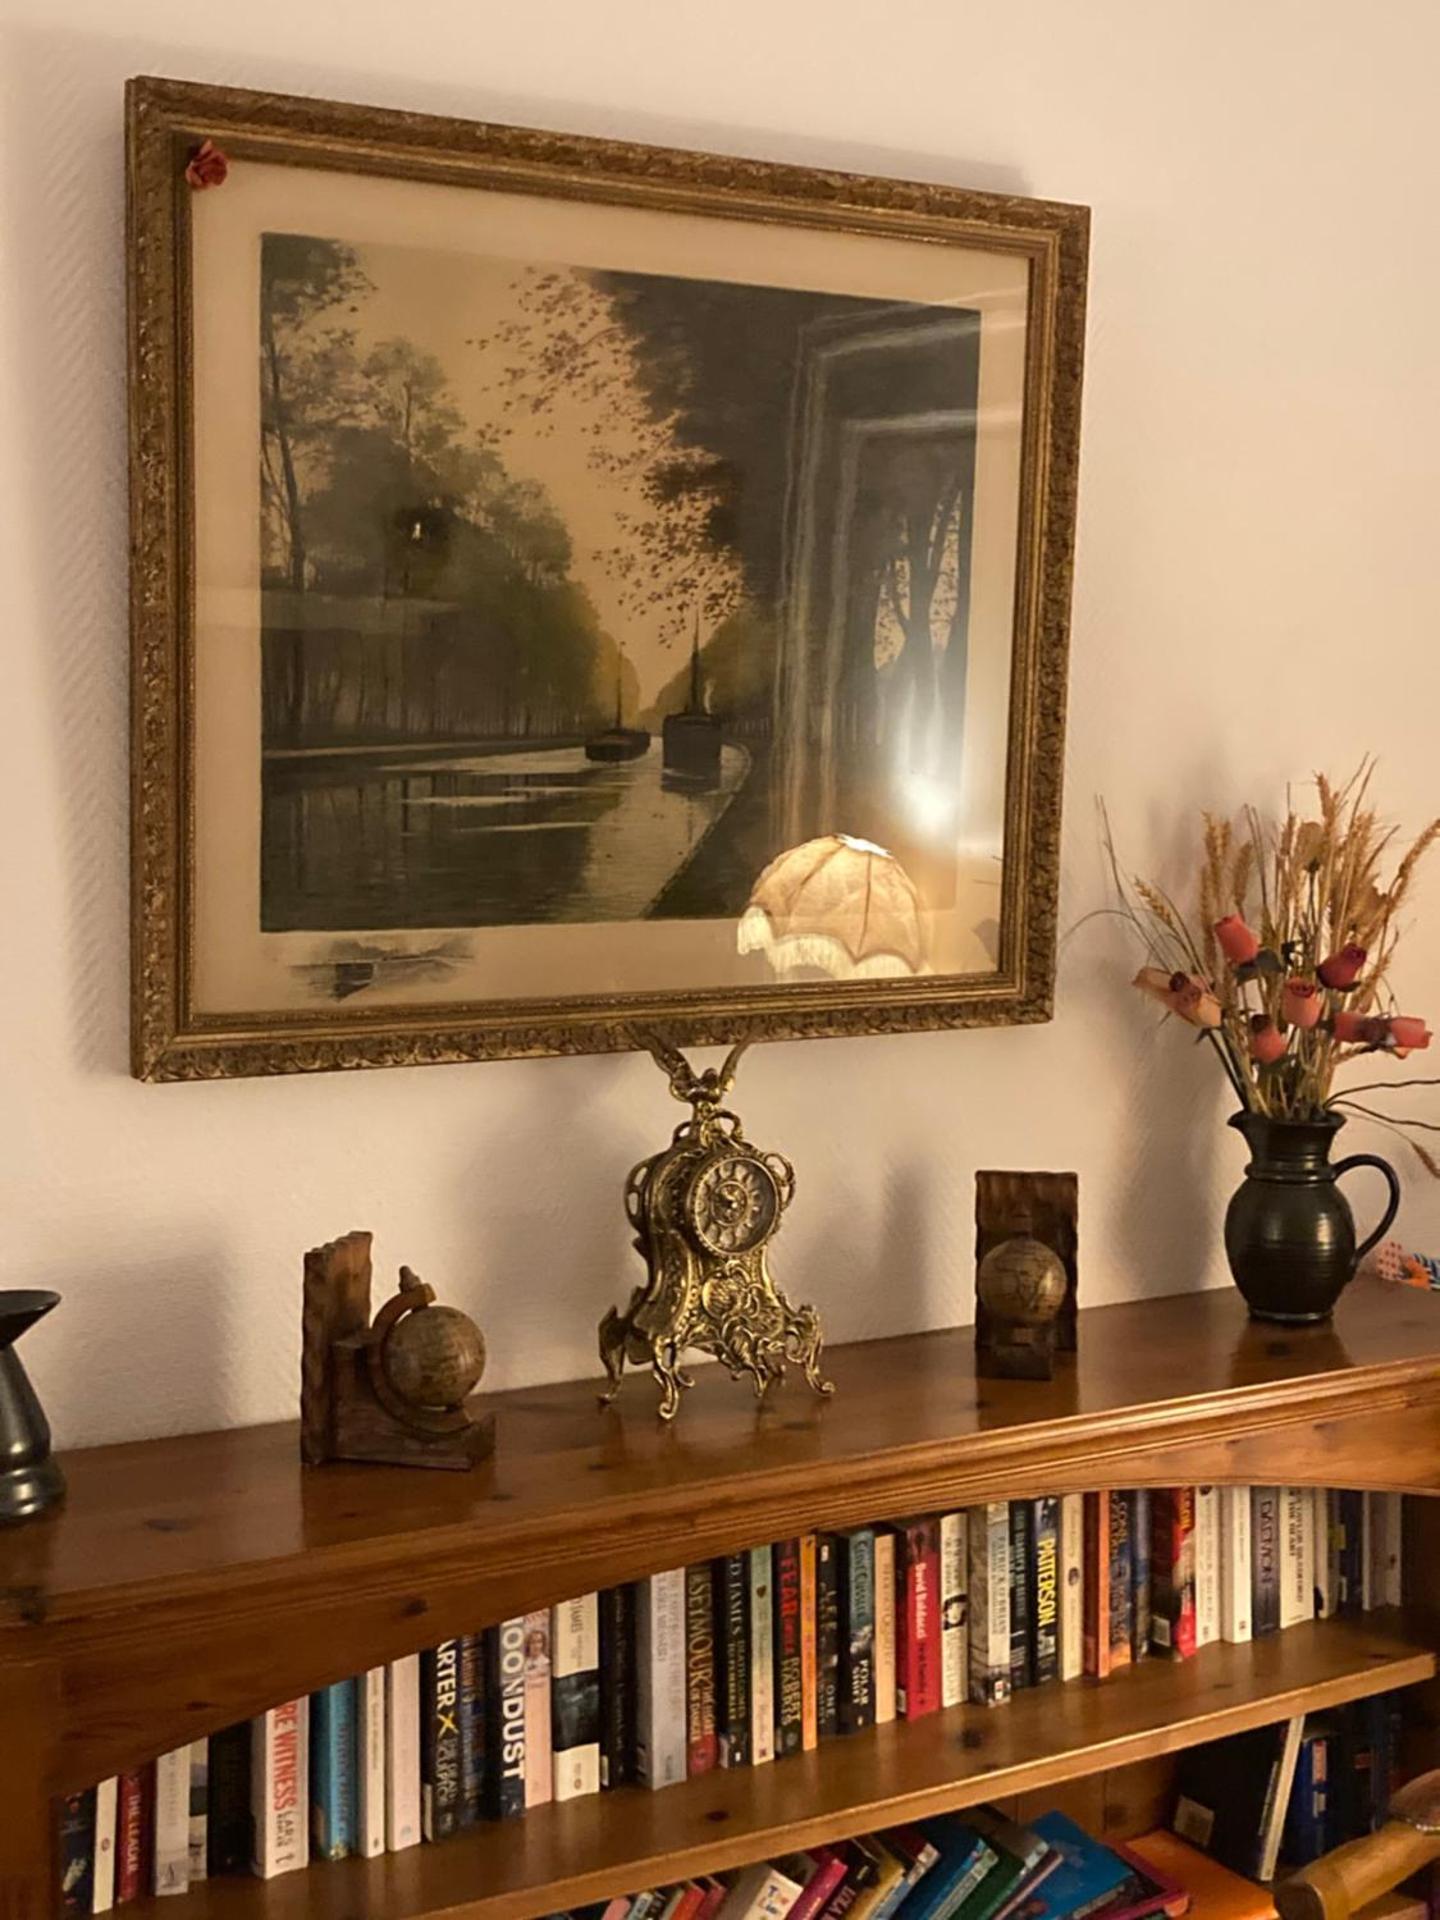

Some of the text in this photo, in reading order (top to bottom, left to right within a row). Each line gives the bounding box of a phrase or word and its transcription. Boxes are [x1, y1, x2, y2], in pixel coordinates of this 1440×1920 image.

[729, 1582, 744, 1637] JAMES
[781, 1558, 799, 1618] FEAR
[1037, 1539, 1057, 1627] PATTERSON
[688, 1583, 714, 1688] SEYMOUR
[858, 1659, 870, 1706] POLAR
[273, 1729, 299, 1812] WITNESS
